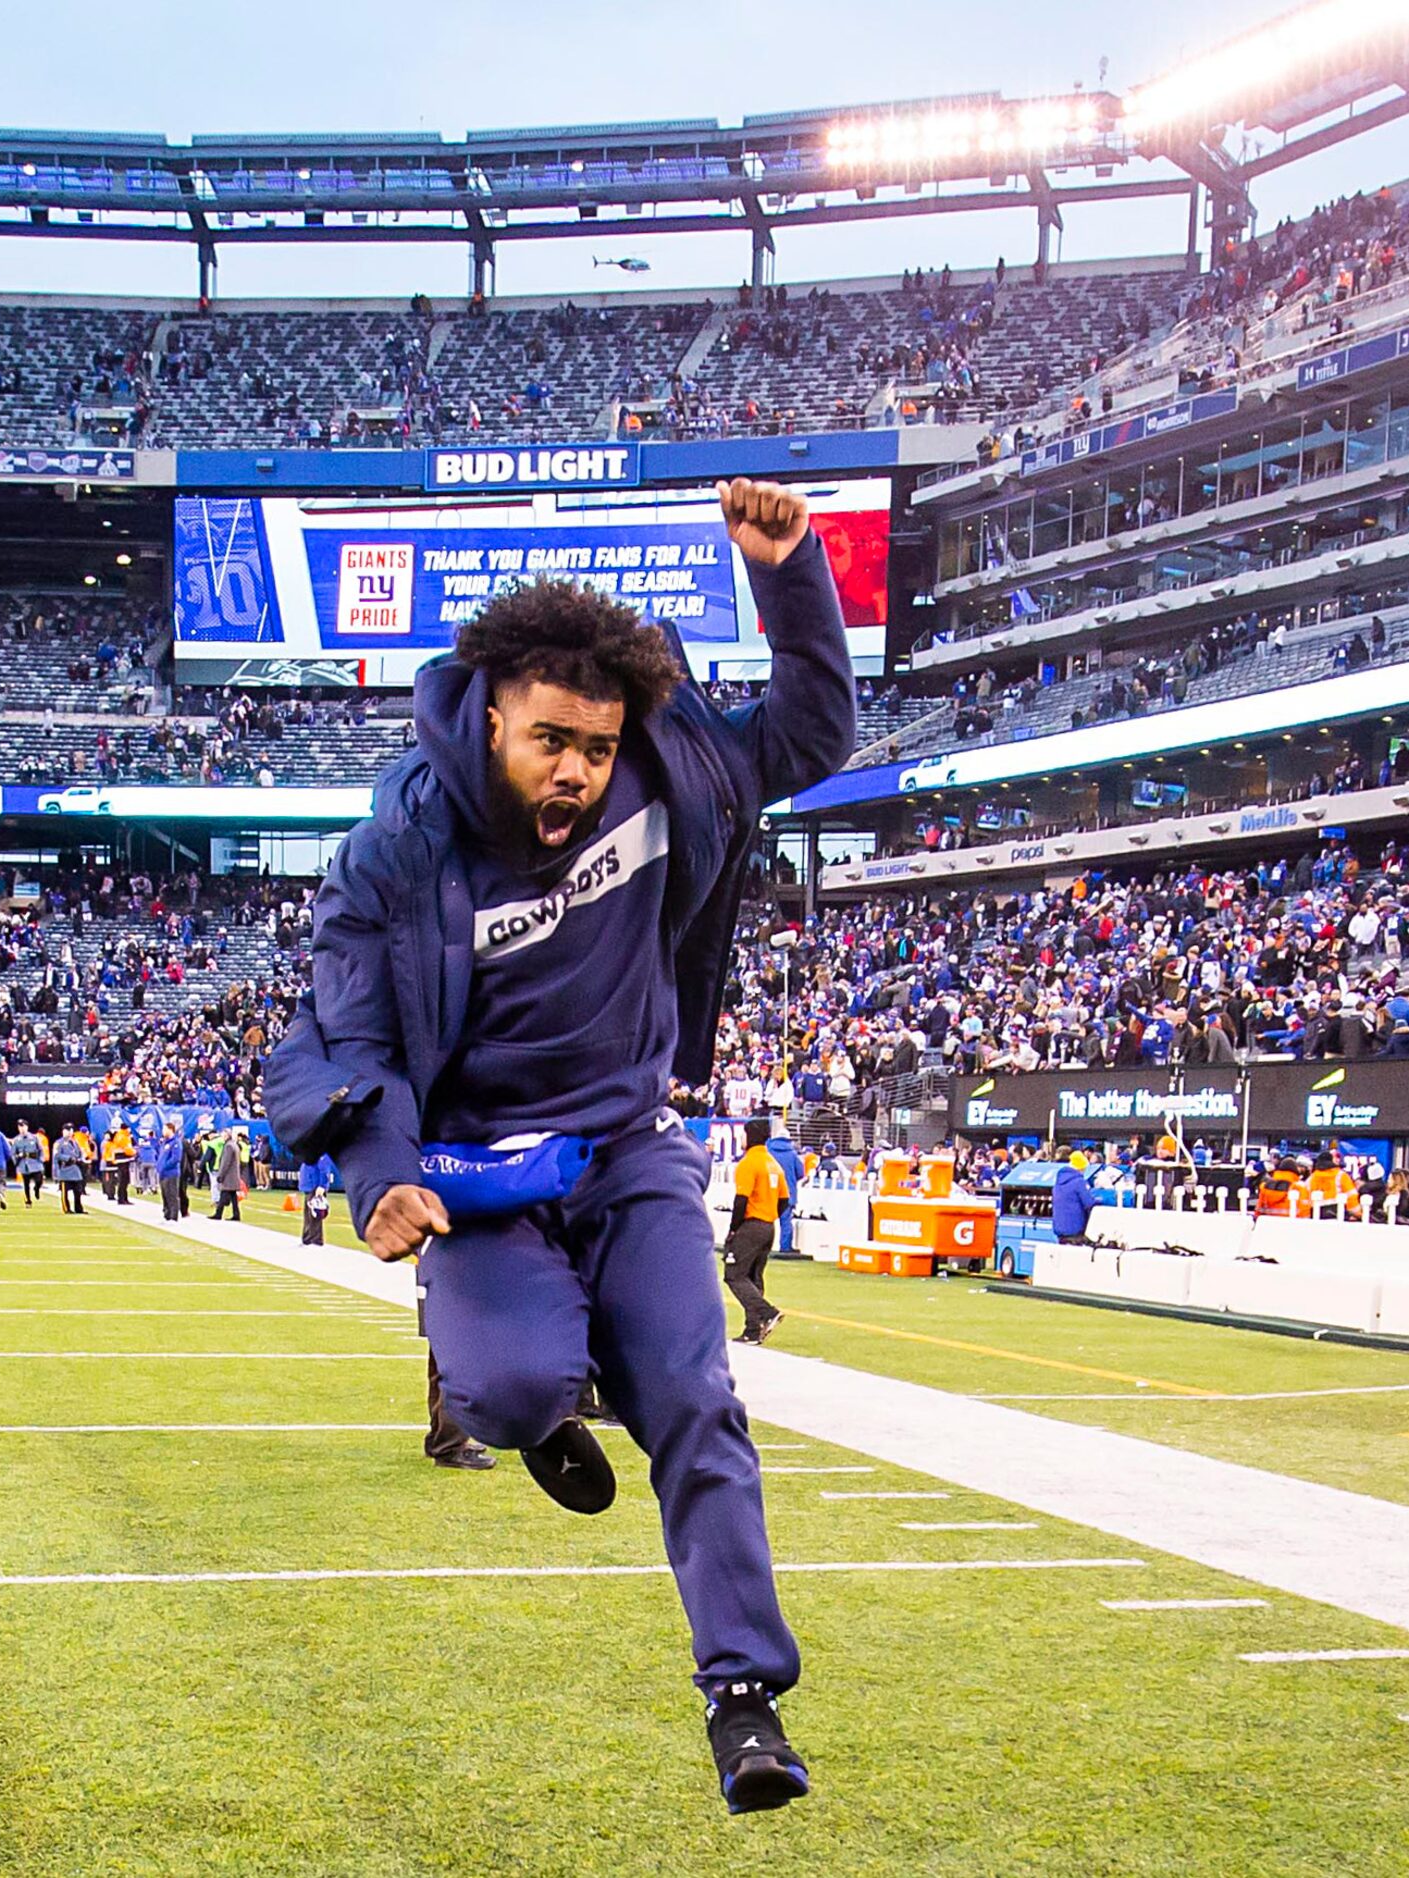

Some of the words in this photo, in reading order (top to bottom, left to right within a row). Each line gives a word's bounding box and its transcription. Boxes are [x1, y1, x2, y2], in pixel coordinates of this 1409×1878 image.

[436, 453, 515, 483] BUD
[347, 551, 407, 569] GIANTS
[423, 550, 483, 571] THANK
[489, 549, 522, 570] YOU
[526, 548, 591, 569] GIANTS
[594, 546, 643, 568] FANS
[645, 546, 681, 567] FOR
[683, 544, 718, 565] ALL
[443, 575, 490, 596] YOUR
[621, 571, 697, 593] SEASON.
[350, 608, 398, 627] PRIDE
[652, 596, 706, 618] YEAR!
[1241, 808, 1298, 832] MetLife
[1011, 845, 1045, 863] pepsi
[967, 1100, 990, 1126] EY
[1060, 1091, 1086, 1116] The
[1088, 1089, 1134, 1116] better
[1136, 1088, 1162, 1116] the
[1307, 1094, 1337, 1126] EY
[953, 1220, 974, 1246] G
